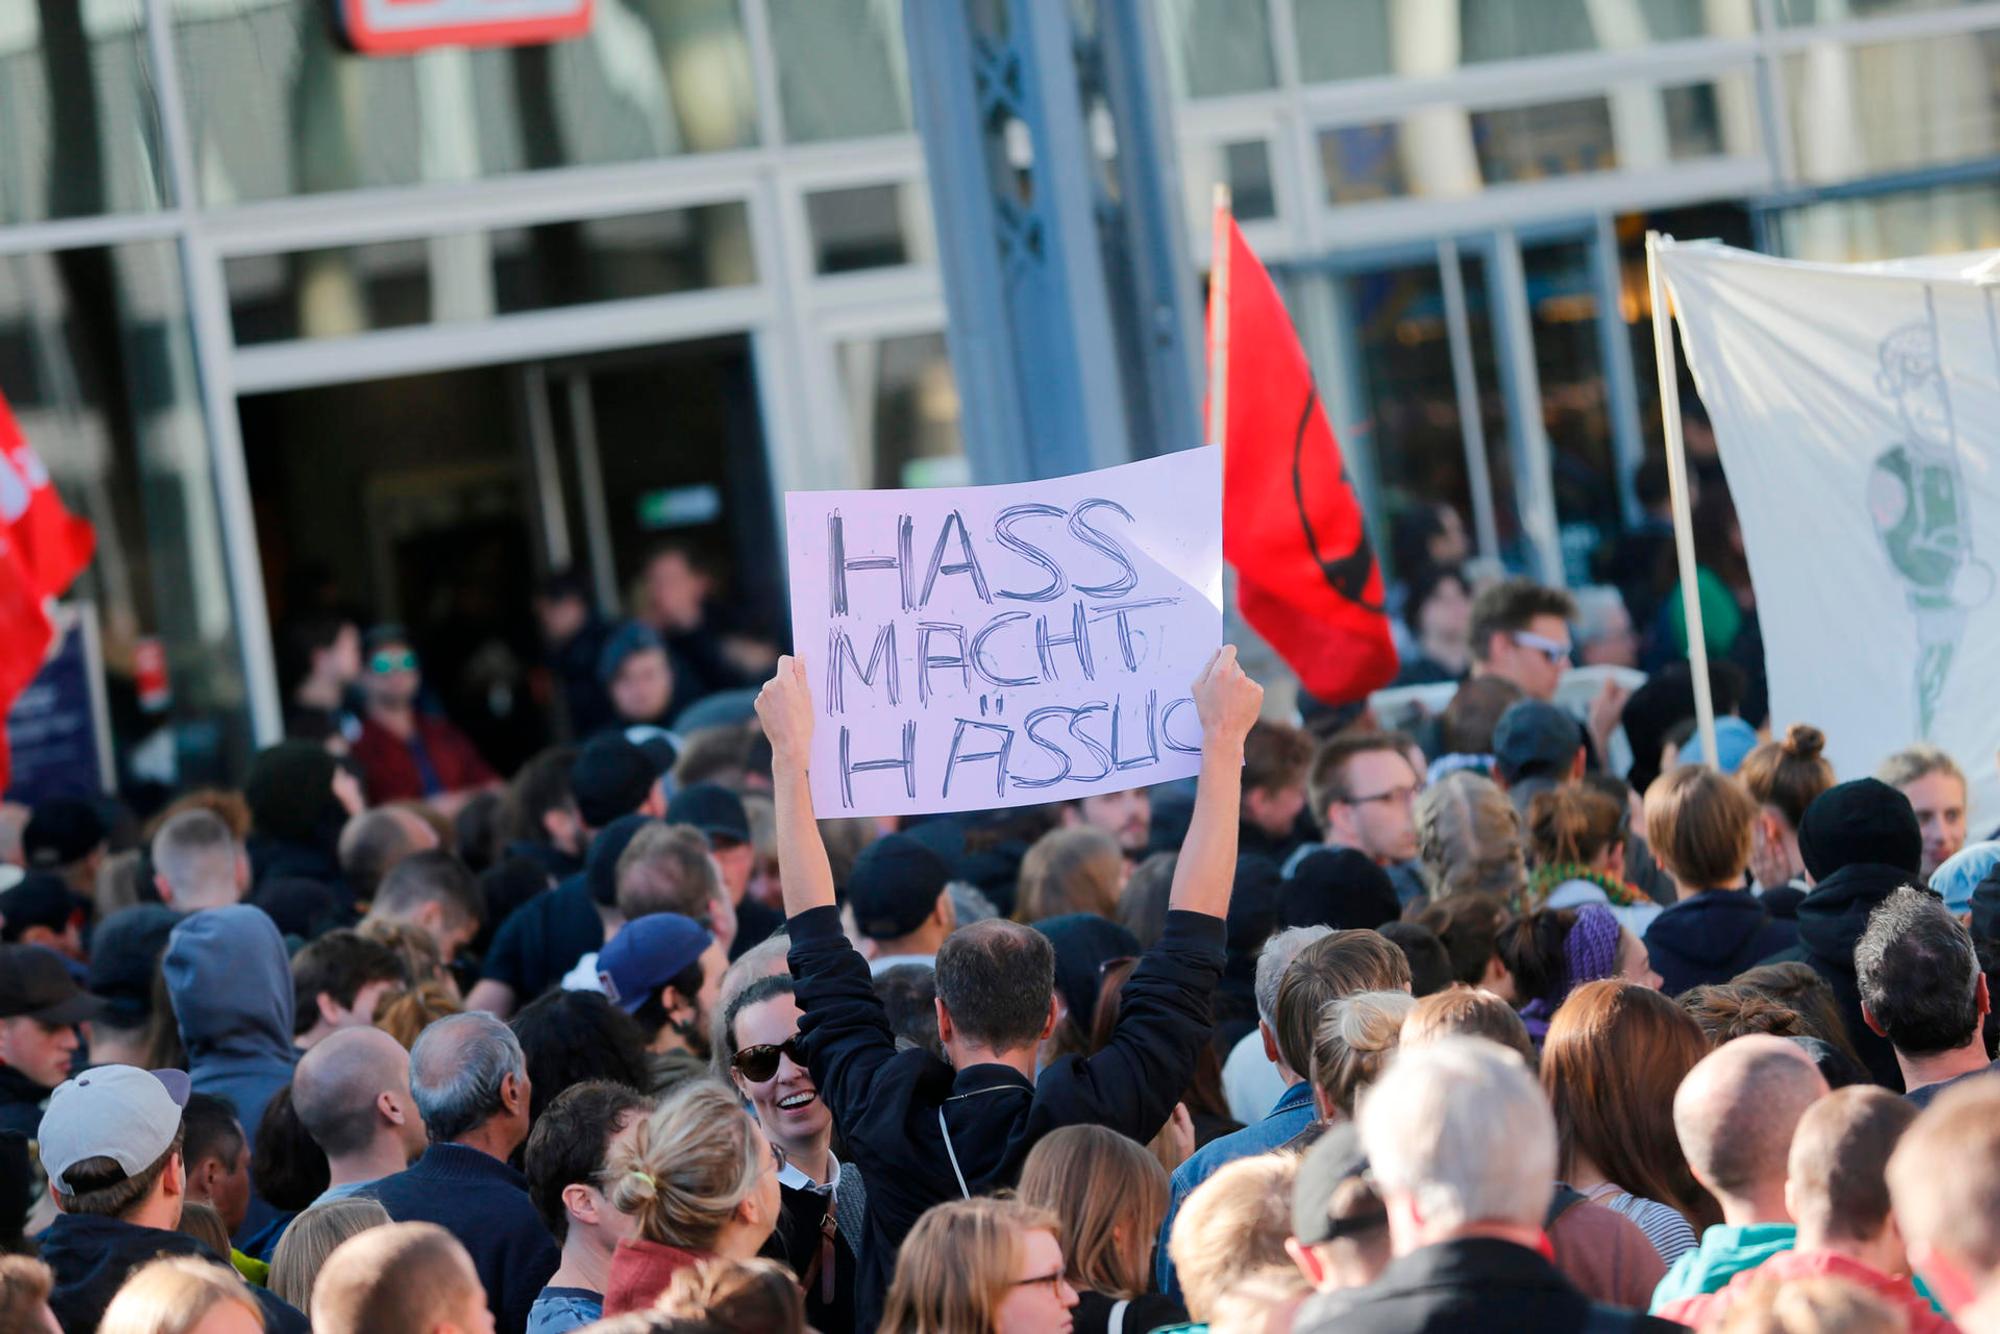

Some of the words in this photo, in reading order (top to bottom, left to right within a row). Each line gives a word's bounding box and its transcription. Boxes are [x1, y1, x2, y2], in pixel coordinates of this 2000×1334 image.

[827, 497, 1138, 617] HASS
[826, 597, 1181, 717] MACHT
[838, 688, 1203, 808] HÄSSLIC
